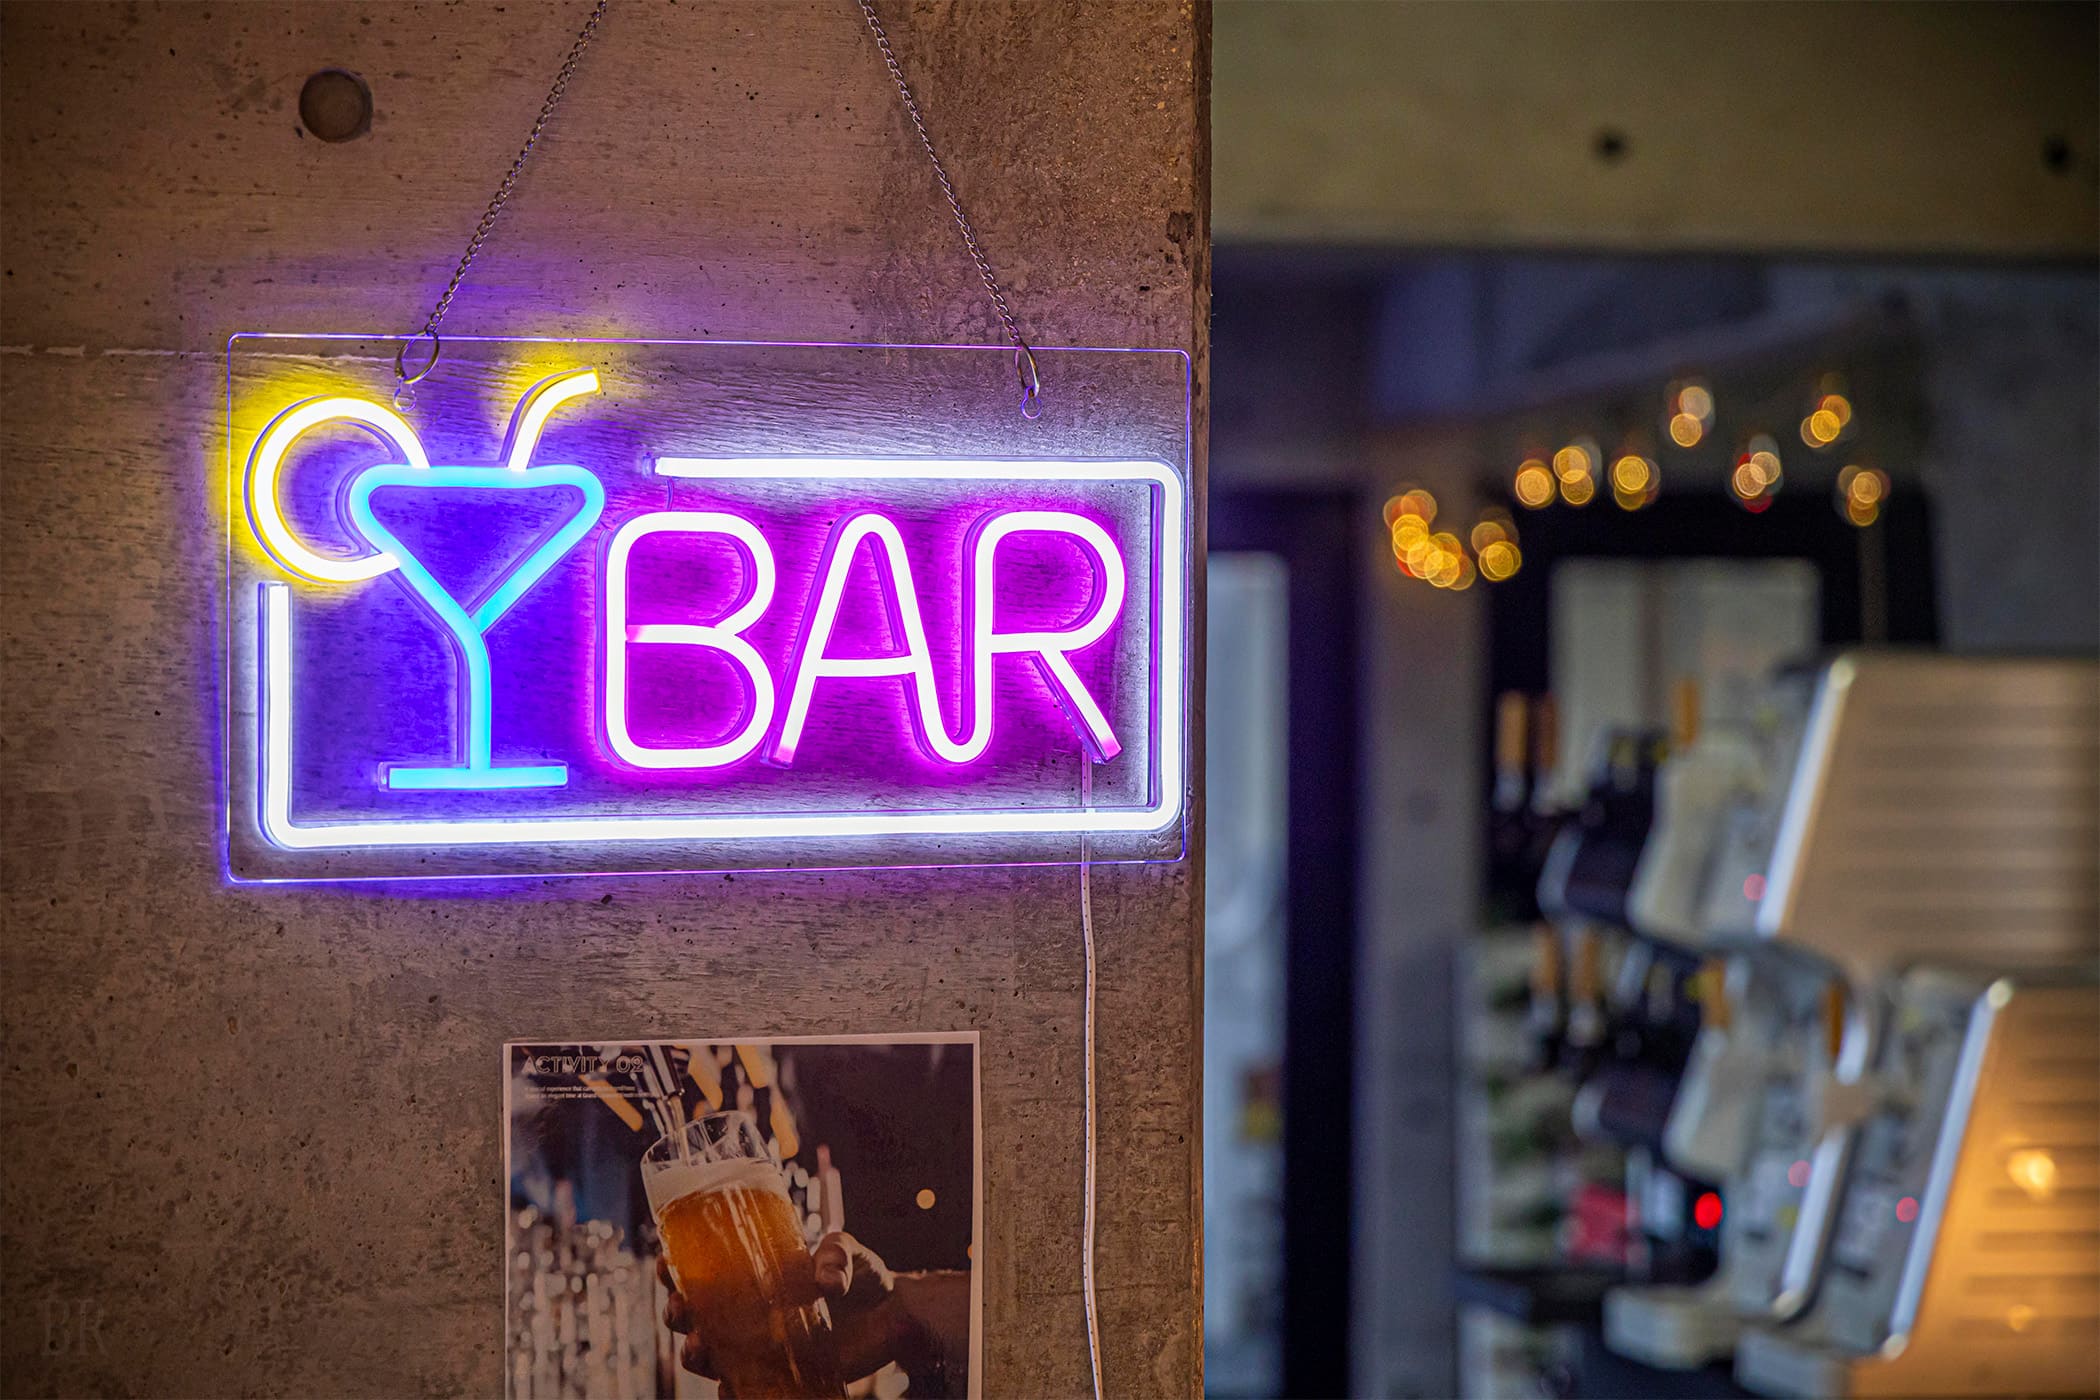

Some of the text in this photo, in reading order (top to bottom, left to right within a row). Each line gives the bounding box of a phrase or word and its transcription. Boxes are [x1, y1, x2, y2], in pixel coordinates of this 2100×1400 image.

[604, 510, 1126, 769] BAR
[521, 1056, 644, 1073] ACTIVITY 02
